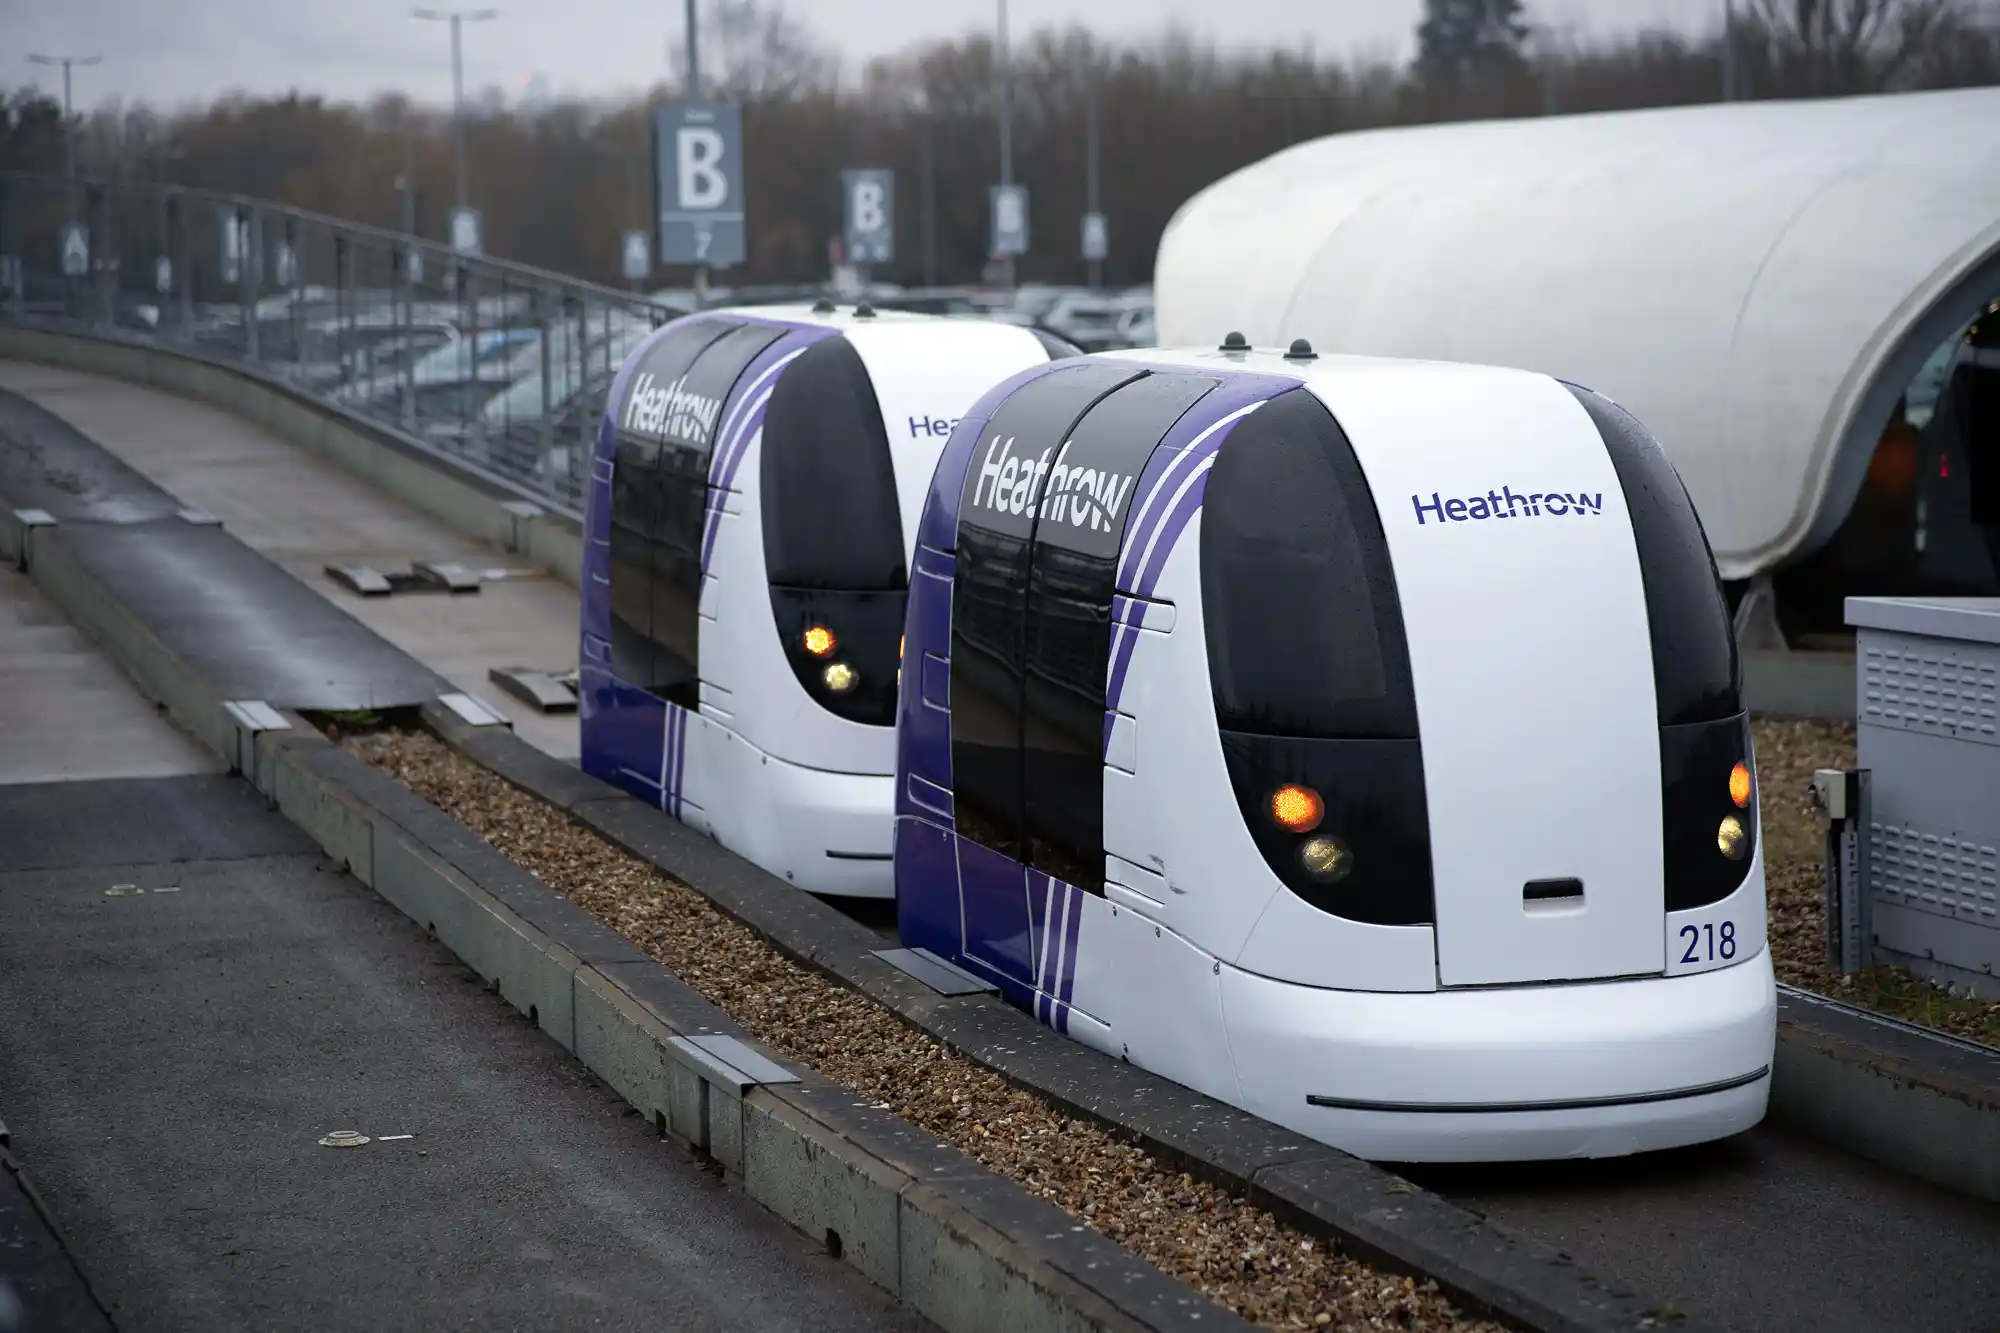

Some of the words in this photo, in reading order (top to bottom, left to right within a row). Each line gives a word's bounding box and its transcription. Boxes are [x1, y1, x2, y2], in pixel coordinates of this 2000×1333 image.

[677, 128, 728, 209] B
[854, 182, 885, 231] B
[625, 372, 720, 444] Heathrow
[973, 434, 1132, 533] Heathrow
[1411, 485, 1602, 525] Heathrow
[1679, 920, 1736, 964] 218
